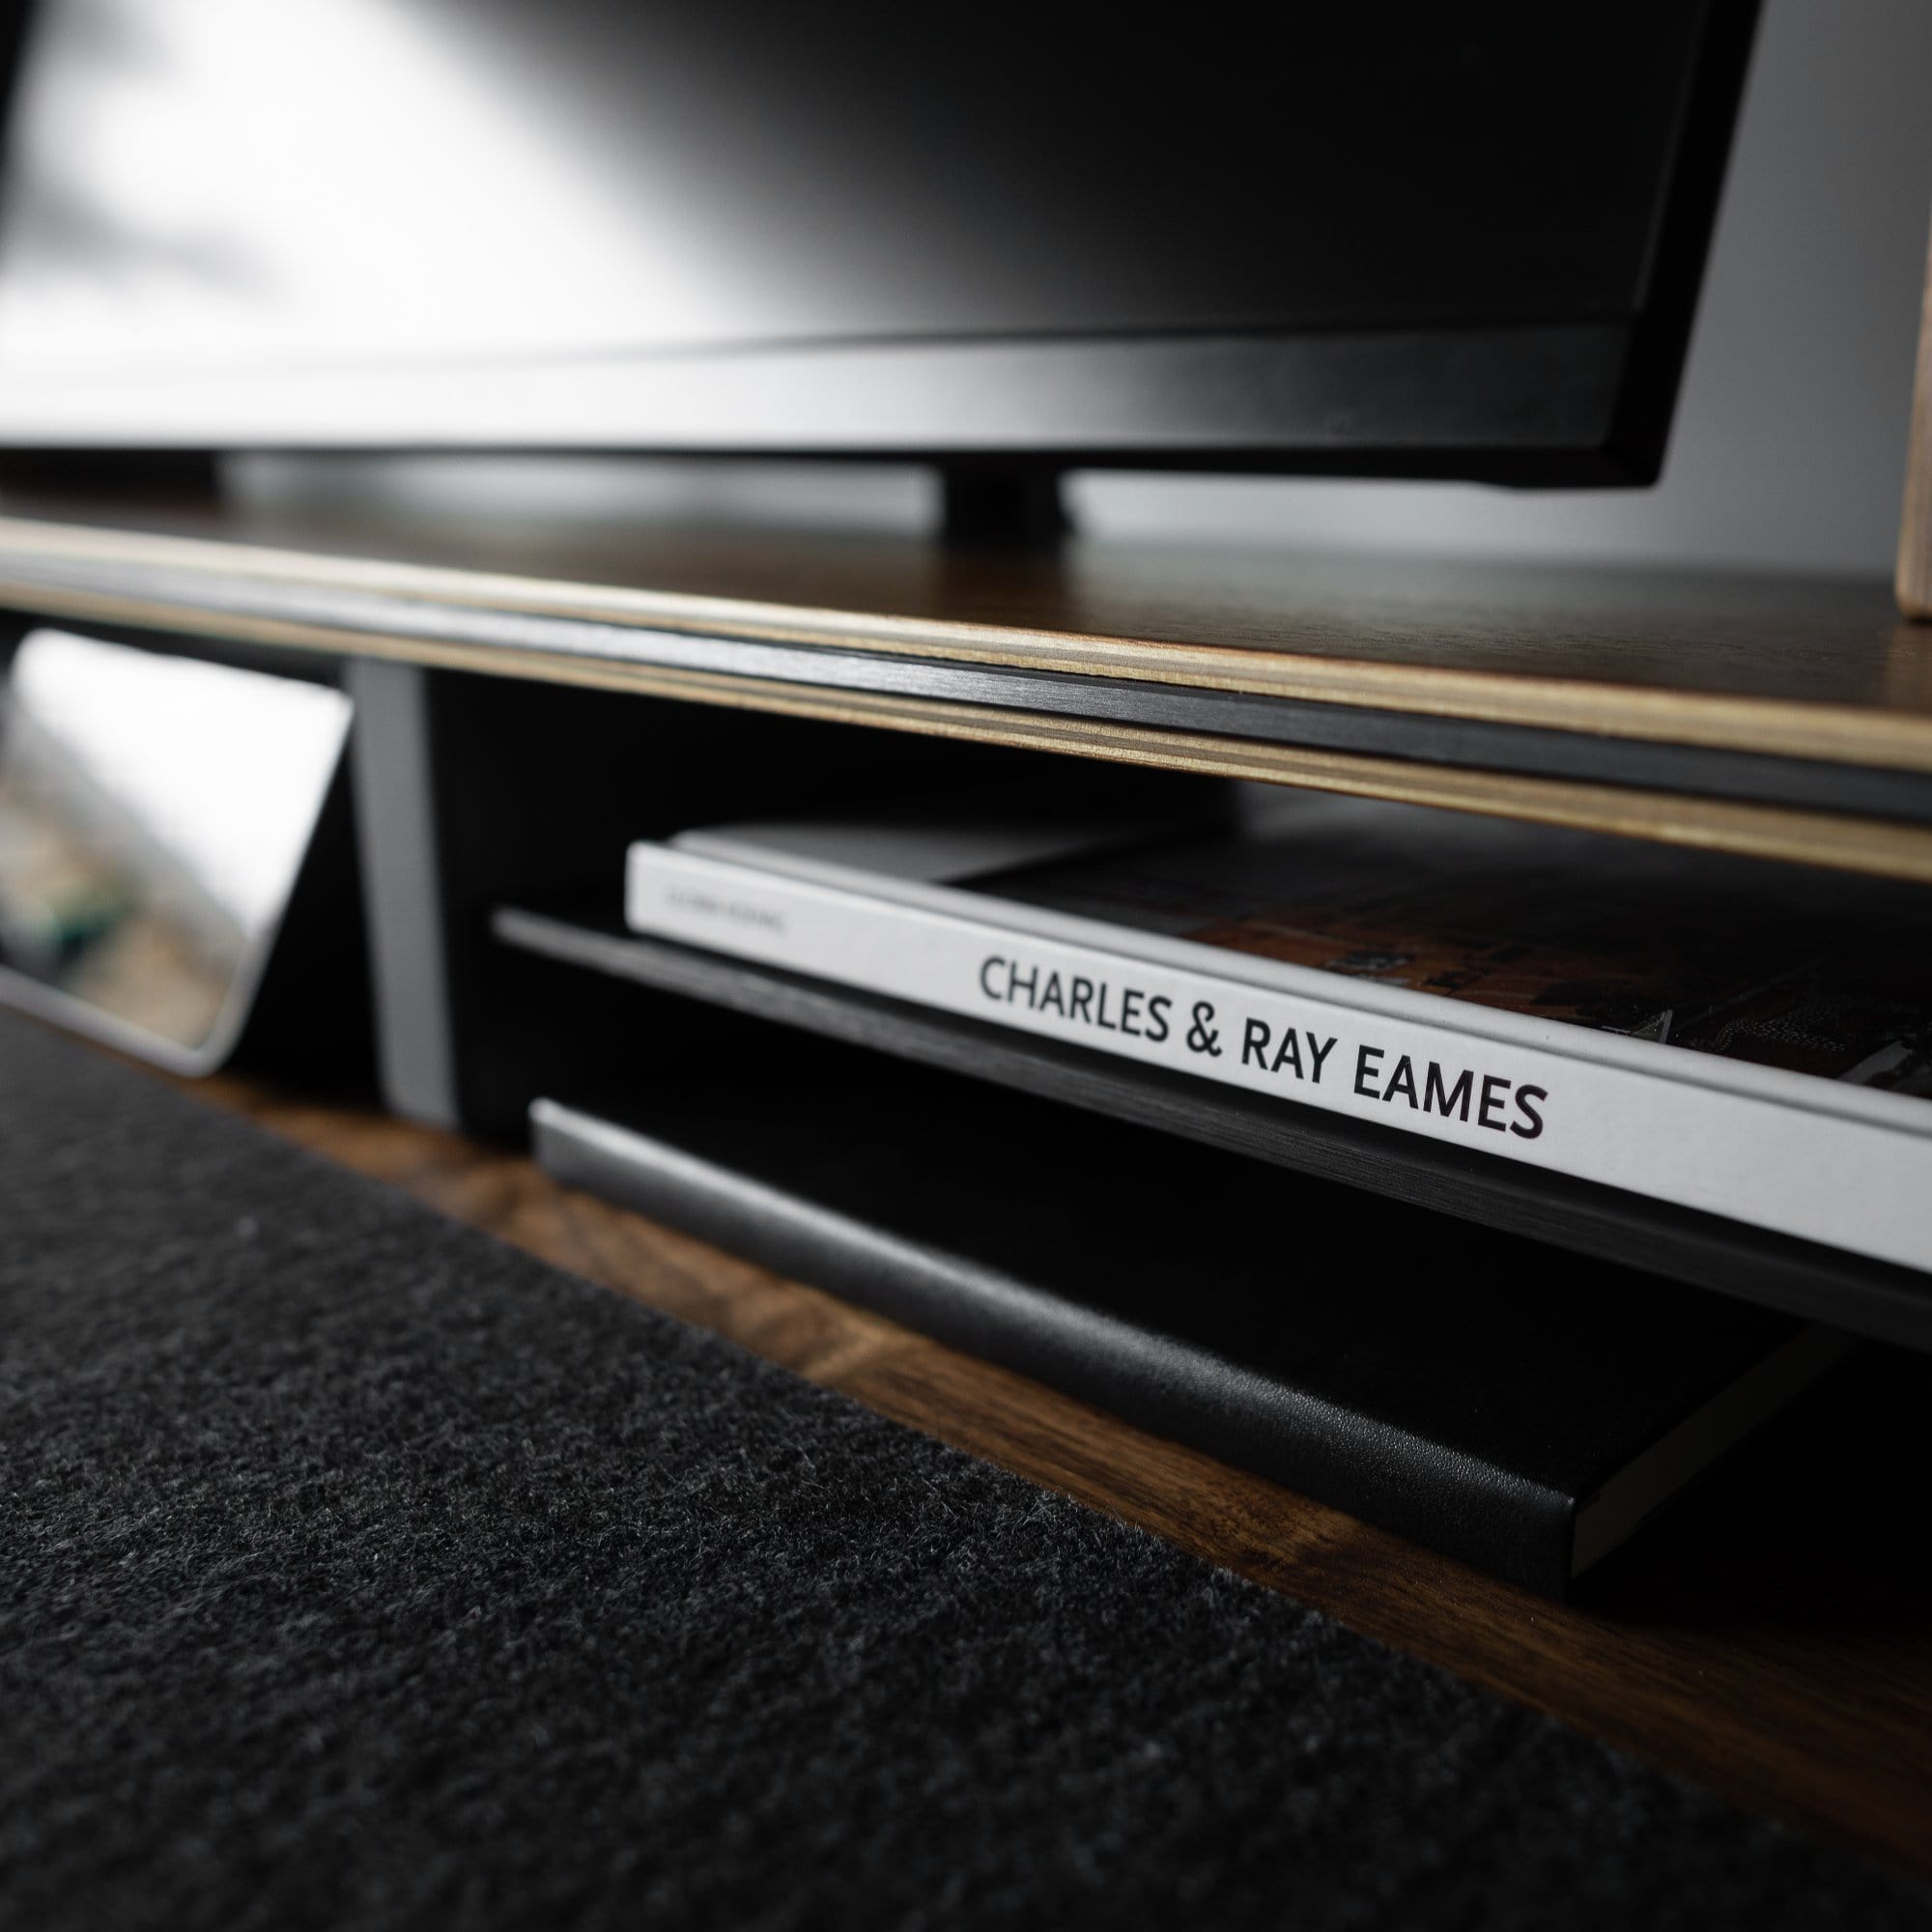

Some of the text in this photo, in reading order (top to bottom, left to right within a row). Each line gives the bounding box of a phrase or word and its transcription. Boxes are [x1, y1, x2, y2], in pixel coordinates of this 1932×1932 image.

[980, 956, 1549, 1141] CHARLES & RAY EAMES
